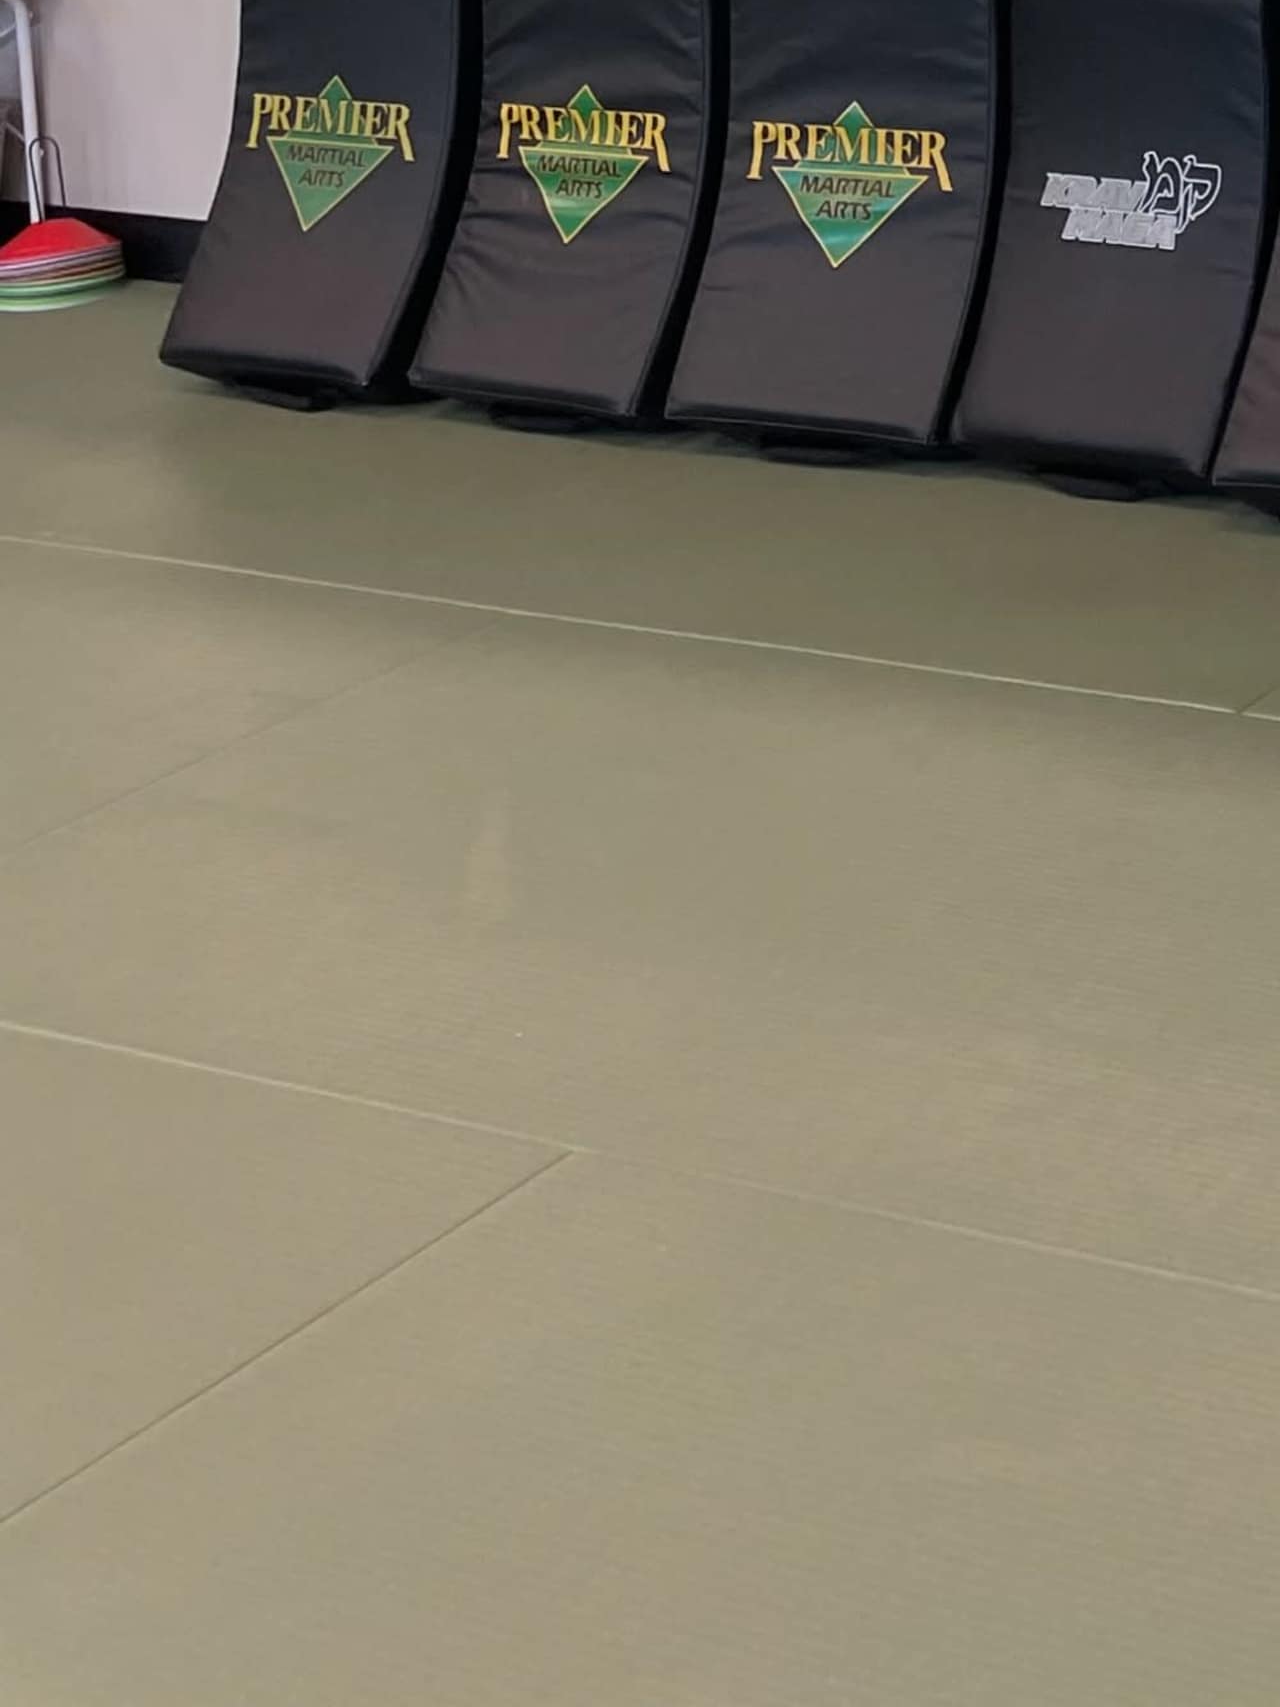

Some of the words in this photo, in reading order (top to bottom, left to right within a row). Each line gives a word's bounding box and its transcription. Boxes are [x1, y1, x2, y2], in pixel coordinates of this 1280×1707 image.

[246, 93, 415, 161] PREMIER
[496, 103, 672, 173] PREMIER
[288, 145, 367, 167] MARTIAL
[537, 154, 622, 178] MARTIAL
[746, 121, 953, 192] PREMIER
[298, 169, 345, 188] ARTS
[555, 179, 604, 199] ARTS
[800, 175, 896, 198] MARTIAL
[816, 200, 872, 220] ARTS
